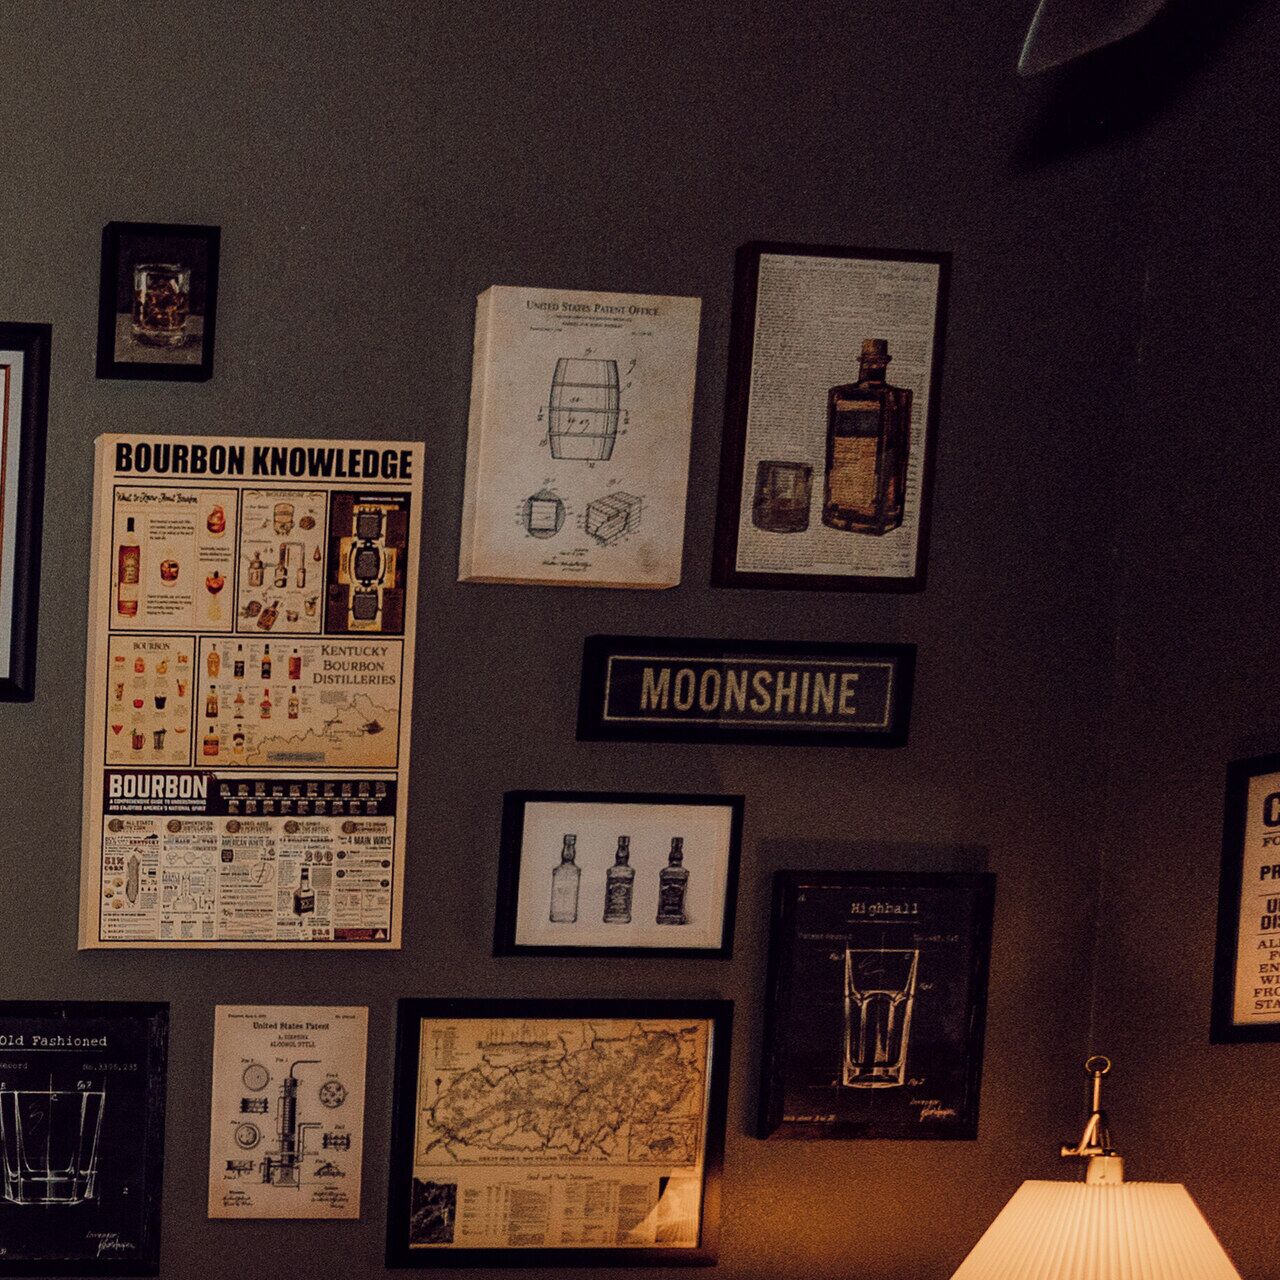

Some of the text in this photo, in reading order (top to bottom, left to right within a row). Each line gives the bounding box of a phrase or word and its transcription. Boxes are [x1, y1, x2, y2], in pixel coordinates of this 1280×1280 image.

[115, 443, 412, 479] BOURBON KNOWLEDGE
[321, 645, 388, 657] KENTUCKY
[323, 660, 385, 671] BOURBON
[313, 673, 396, 685] DISTILLERIES
[640, 668, 859, 716] MOONSHINE
[109, 774, 207, 798] BOURBON
[850, 902, 918, 916] Highball
[253, 1021, 278, 1030] United
[32, 1036, 108, 1047] Fashioned
